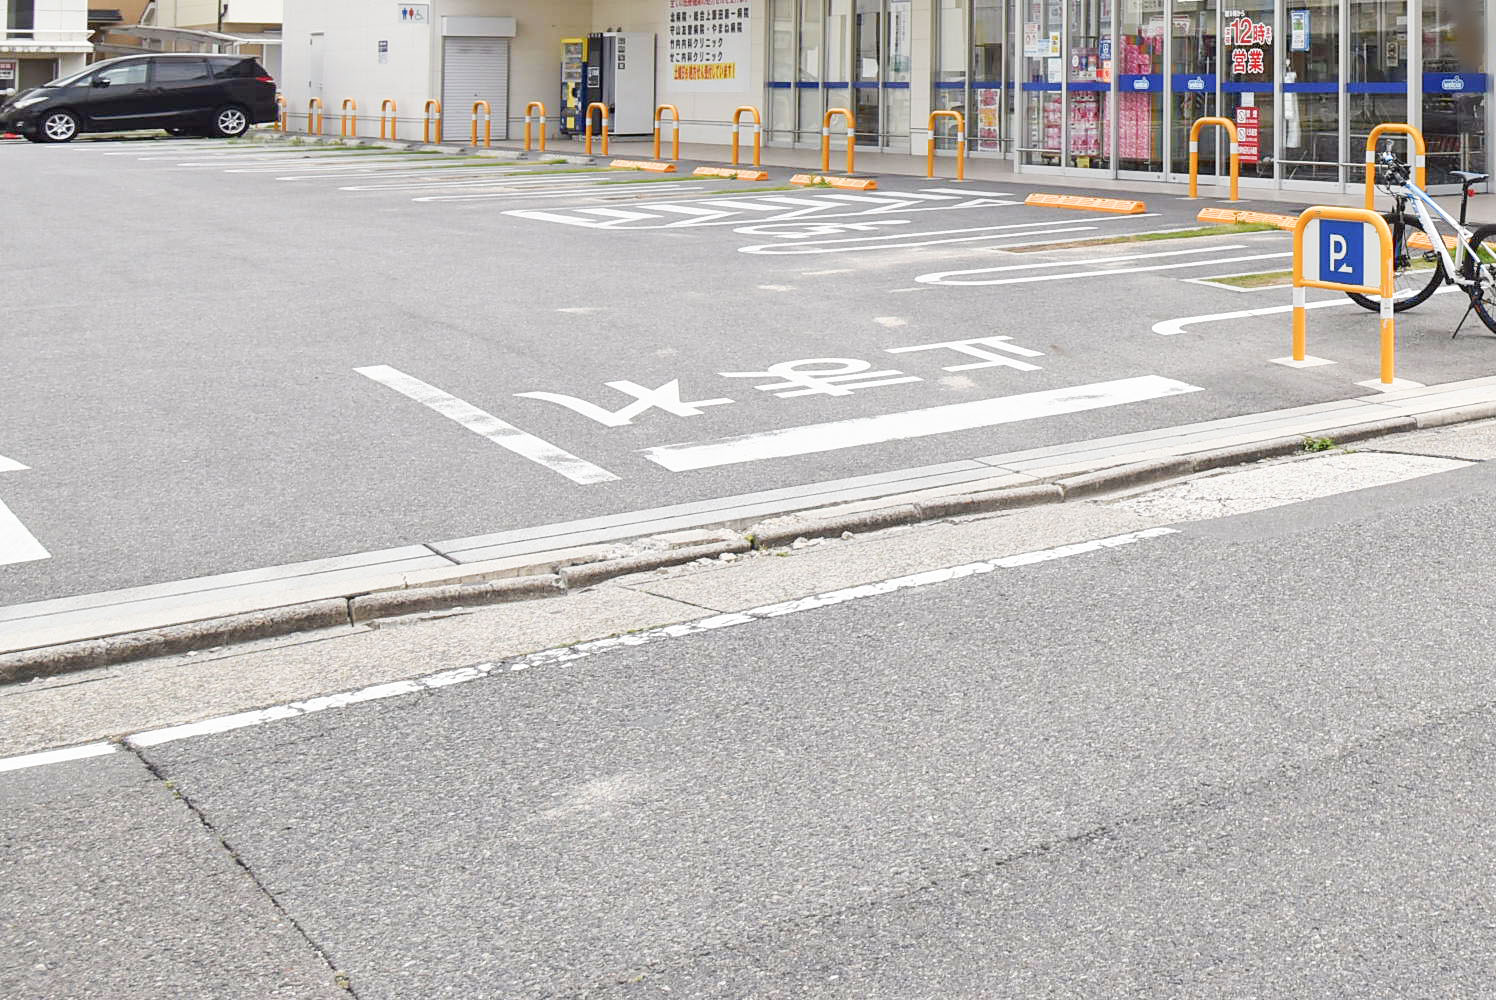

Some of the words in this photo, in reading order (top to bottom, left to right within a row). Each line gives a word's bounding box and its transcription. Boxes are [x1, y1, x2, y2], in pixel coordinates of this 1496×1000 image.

[1232, 49, 1264, 73] 営業
[1329, 234, 1347, 272] P
[513, 335, 1045, 427] 止まれ
